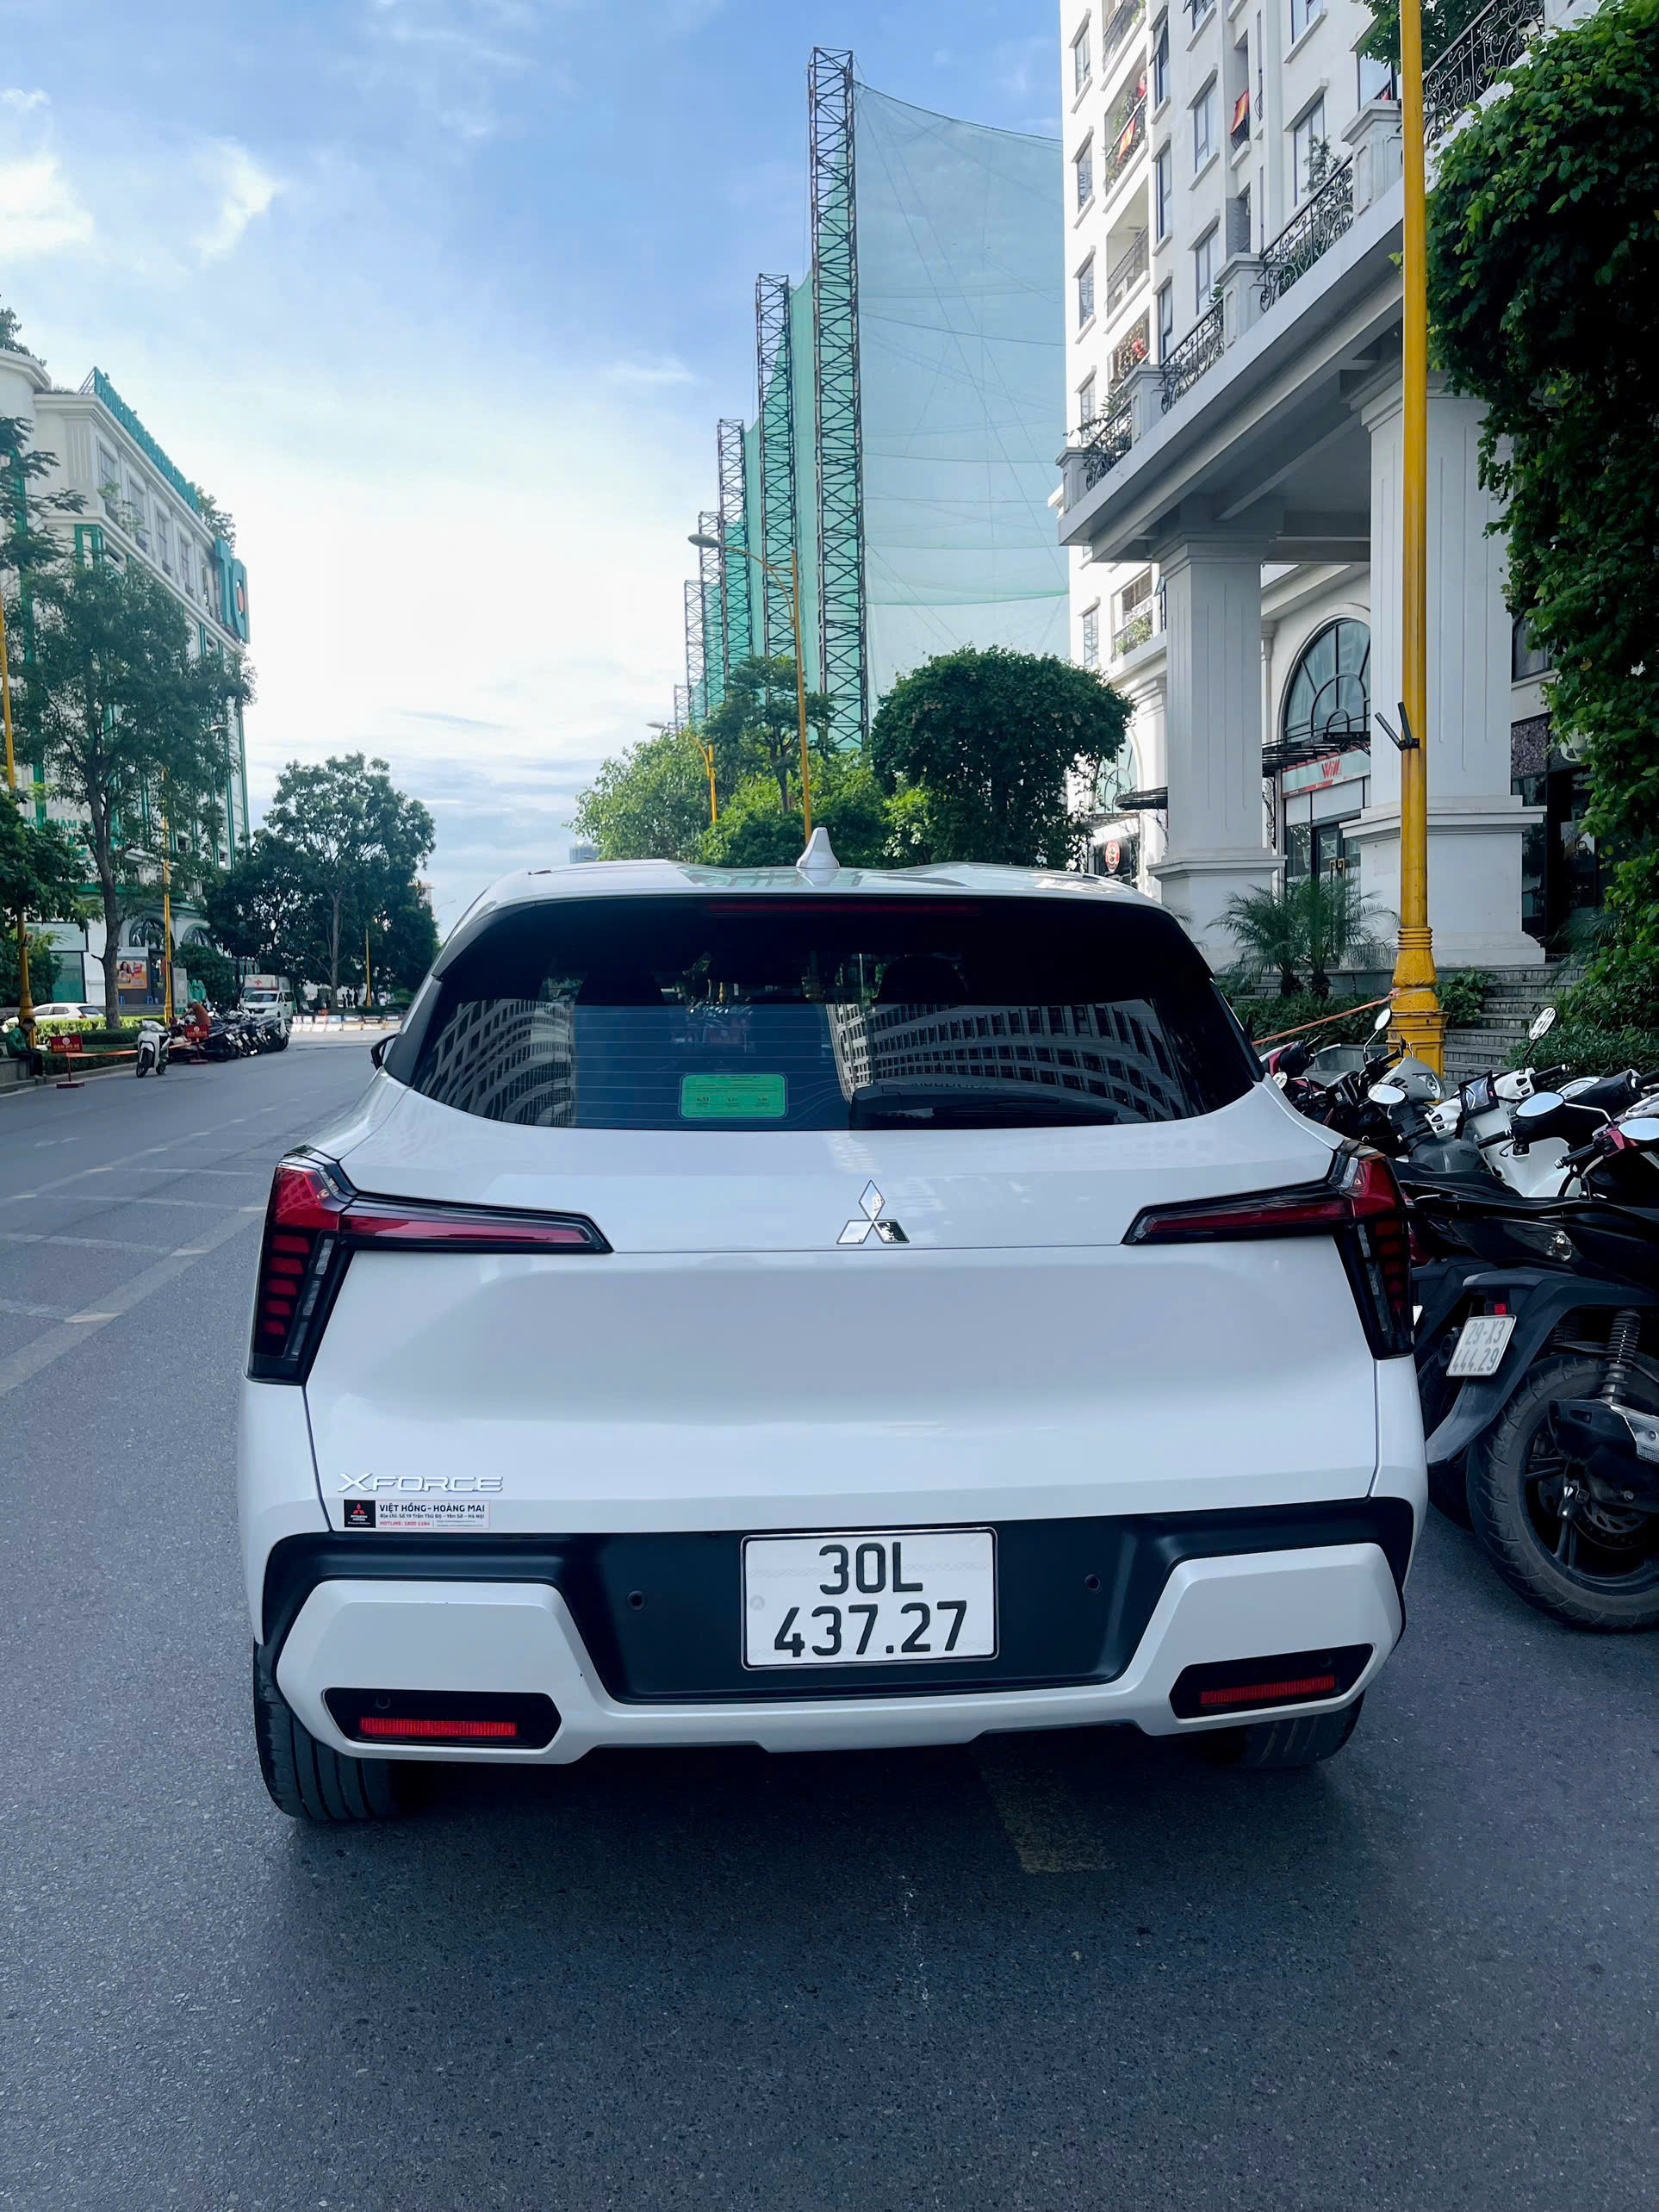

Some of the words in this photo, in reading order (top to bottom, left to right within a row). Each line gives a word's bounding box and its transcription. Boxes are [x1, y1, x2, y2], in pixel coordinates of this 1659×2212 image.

[1452, 1347, 1500, 1372] 444.29
[338, 1473, 503, 1492] XFORCE
[379, 1502, 400, 1513] VIỆT
[468, 1504, 485, 1513] MAI
[819, 1542, 923, 1595] 30L
[774, 1600, 966, 1657] 437.27
